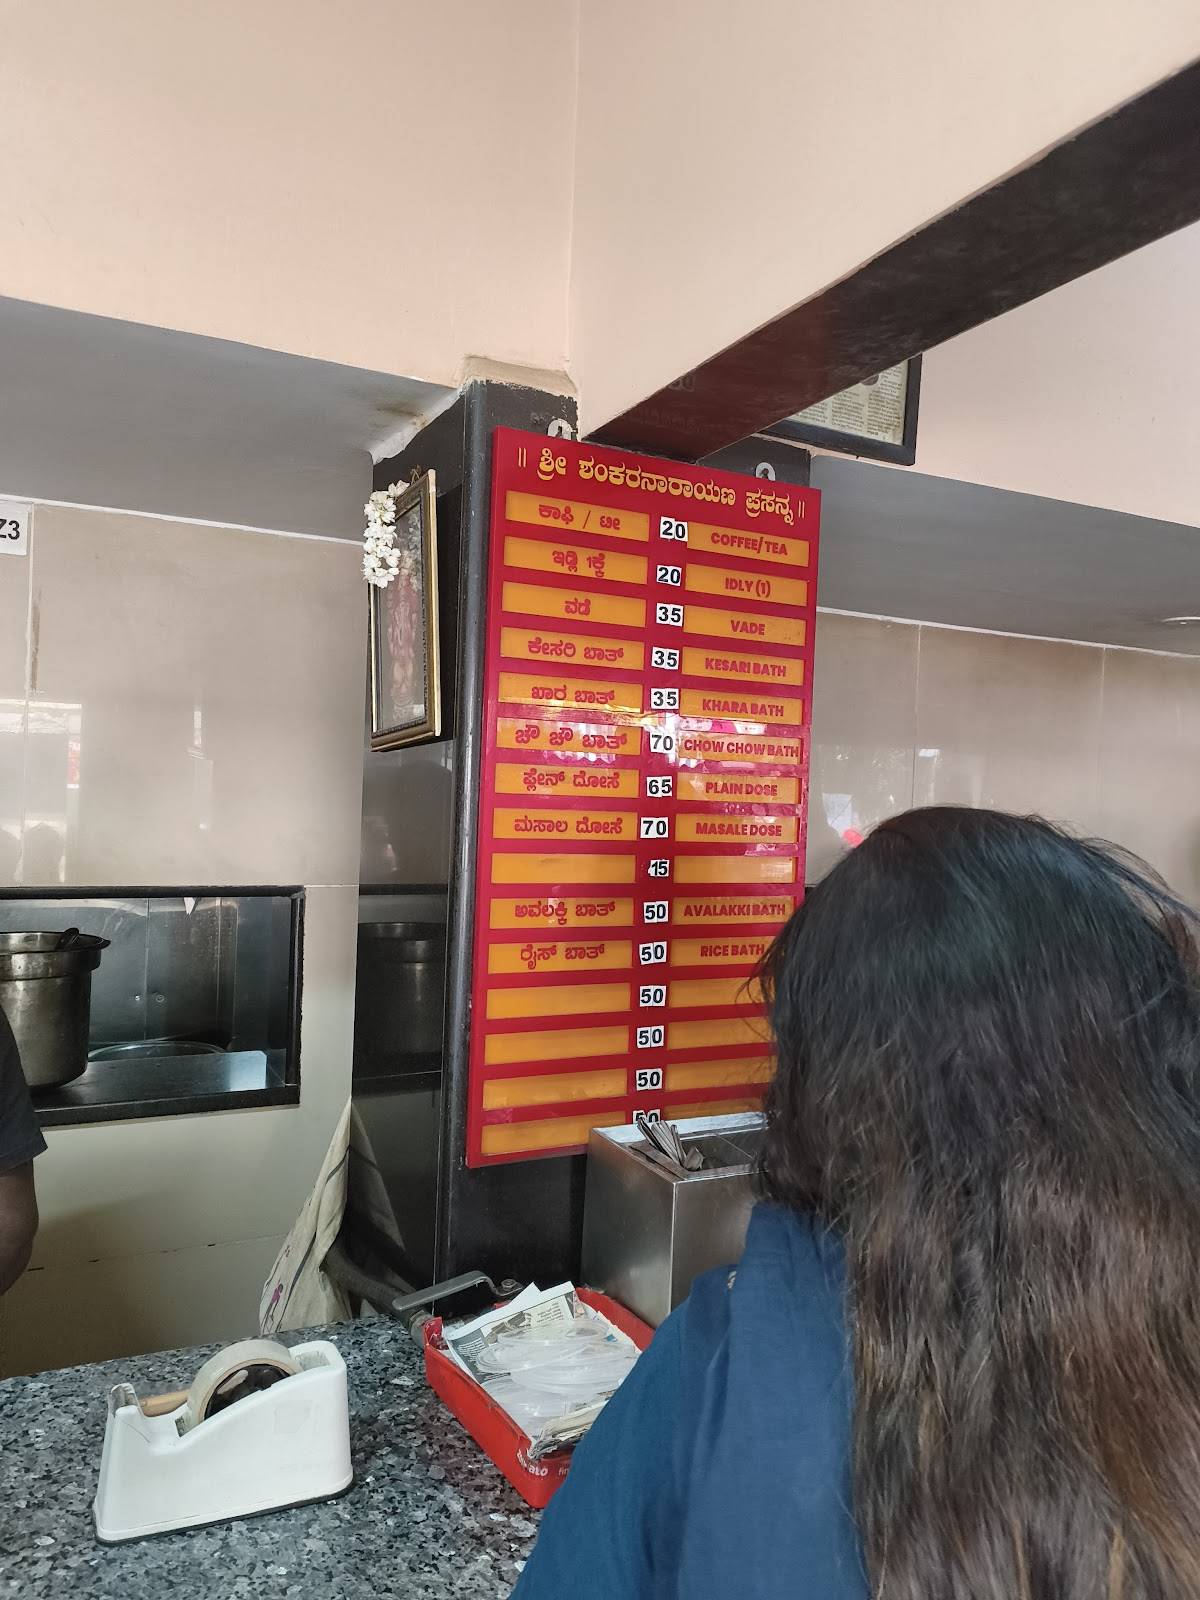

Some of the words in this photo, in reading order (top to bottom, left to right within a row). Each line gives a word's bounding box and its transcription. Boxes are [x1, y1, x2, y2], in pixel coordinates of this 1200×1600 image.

[537, 447, 567, 481] ಶ್ರೀ
[578, 455, 736, 506] ಶಂಕರನಾರಾಯಣ
[745, 487, 794, 525] ಪ್ರಸನ್ನ
[538, 504, 574, 525] ಕಾಫಿ
[600, 515, 620, 530] ಟೀ
[662, 520, 686, 539] 20
[552, 550, 578, 572] ಇಡ್ಲಿ
[658, 566, 681, 584] 20
[725, 577, 754, 592] IDLY
[756, 579, 771, 598] (1)
[564, 598, 591, 616] ವಡೆ
[658, 606, 681, 623] 35
[731, 620, 765, 635] VADE
[528, 637, 576, 657] ಕೇಸರಿ
[584, 646, 624, 661] ಬಾತ್
[654, 650, 677, 667] 35
[705, 657, 751, 674] KESARI
[753, 663, 786, 677] BATH
[531, 685, 567, 699] ಖಾರ
[574, 690, 615, 704] ಬಾತ್
[653, 691, 677, 706] 35
[703, 699, 748, 714] KHARA
[750, 703, 784, 717] BATH
[515, 724, 540, 744] ಚೌ
[549, 726, 573, 746] ಚೌ
[582, 733, 627, 749] ಬಾತ್
[652, 734, 673, 750] 70
[684, 739, 724, 752] CHOW
[727, 741, 766, 755] CHOW
[767, 743, 799, 757] BATH
[523, 768, 566, 791] ಪ್ಲೇನ್
[573, 770, 620, 788] ದೋಸೆ
[648, 779, 672, 794] 65
[705, 782, 744, 795] PLAIN
[745, 784, 777, 796] DOSE
[514, 815, 568, 832] ಮಸಾಲ
[576, 816, 623, 834] ದೋಸೆ
[643, 820, 667, 836] 70
[696, 822, 747, 835] MASALE
[749, 824, 782, 836] DOSE
[651, 861, 668, 876] 15
[515, 901, 567, 925] ಅವಲಕ್ಕಿ
[575, 901, 615, 917] ಬಾತ್
[645, 904, 666, 920] 50
[684, 904, 751, 917] AVALAKKI
[752, 904, 785, 916] BATH
[520, 944, 557, 970] ರೈಸ್
[565, 943, 605, 960] ಬಾತ್
[641, 944, 665, 962] 50
[700, 945, 729, 957] RICE
[731, 944, 764, 956] BATH
[640, 988, 664, 1004] 50
[638, 1028, 662, 1045] 50
[637, 1071, 660, 1087] 50
